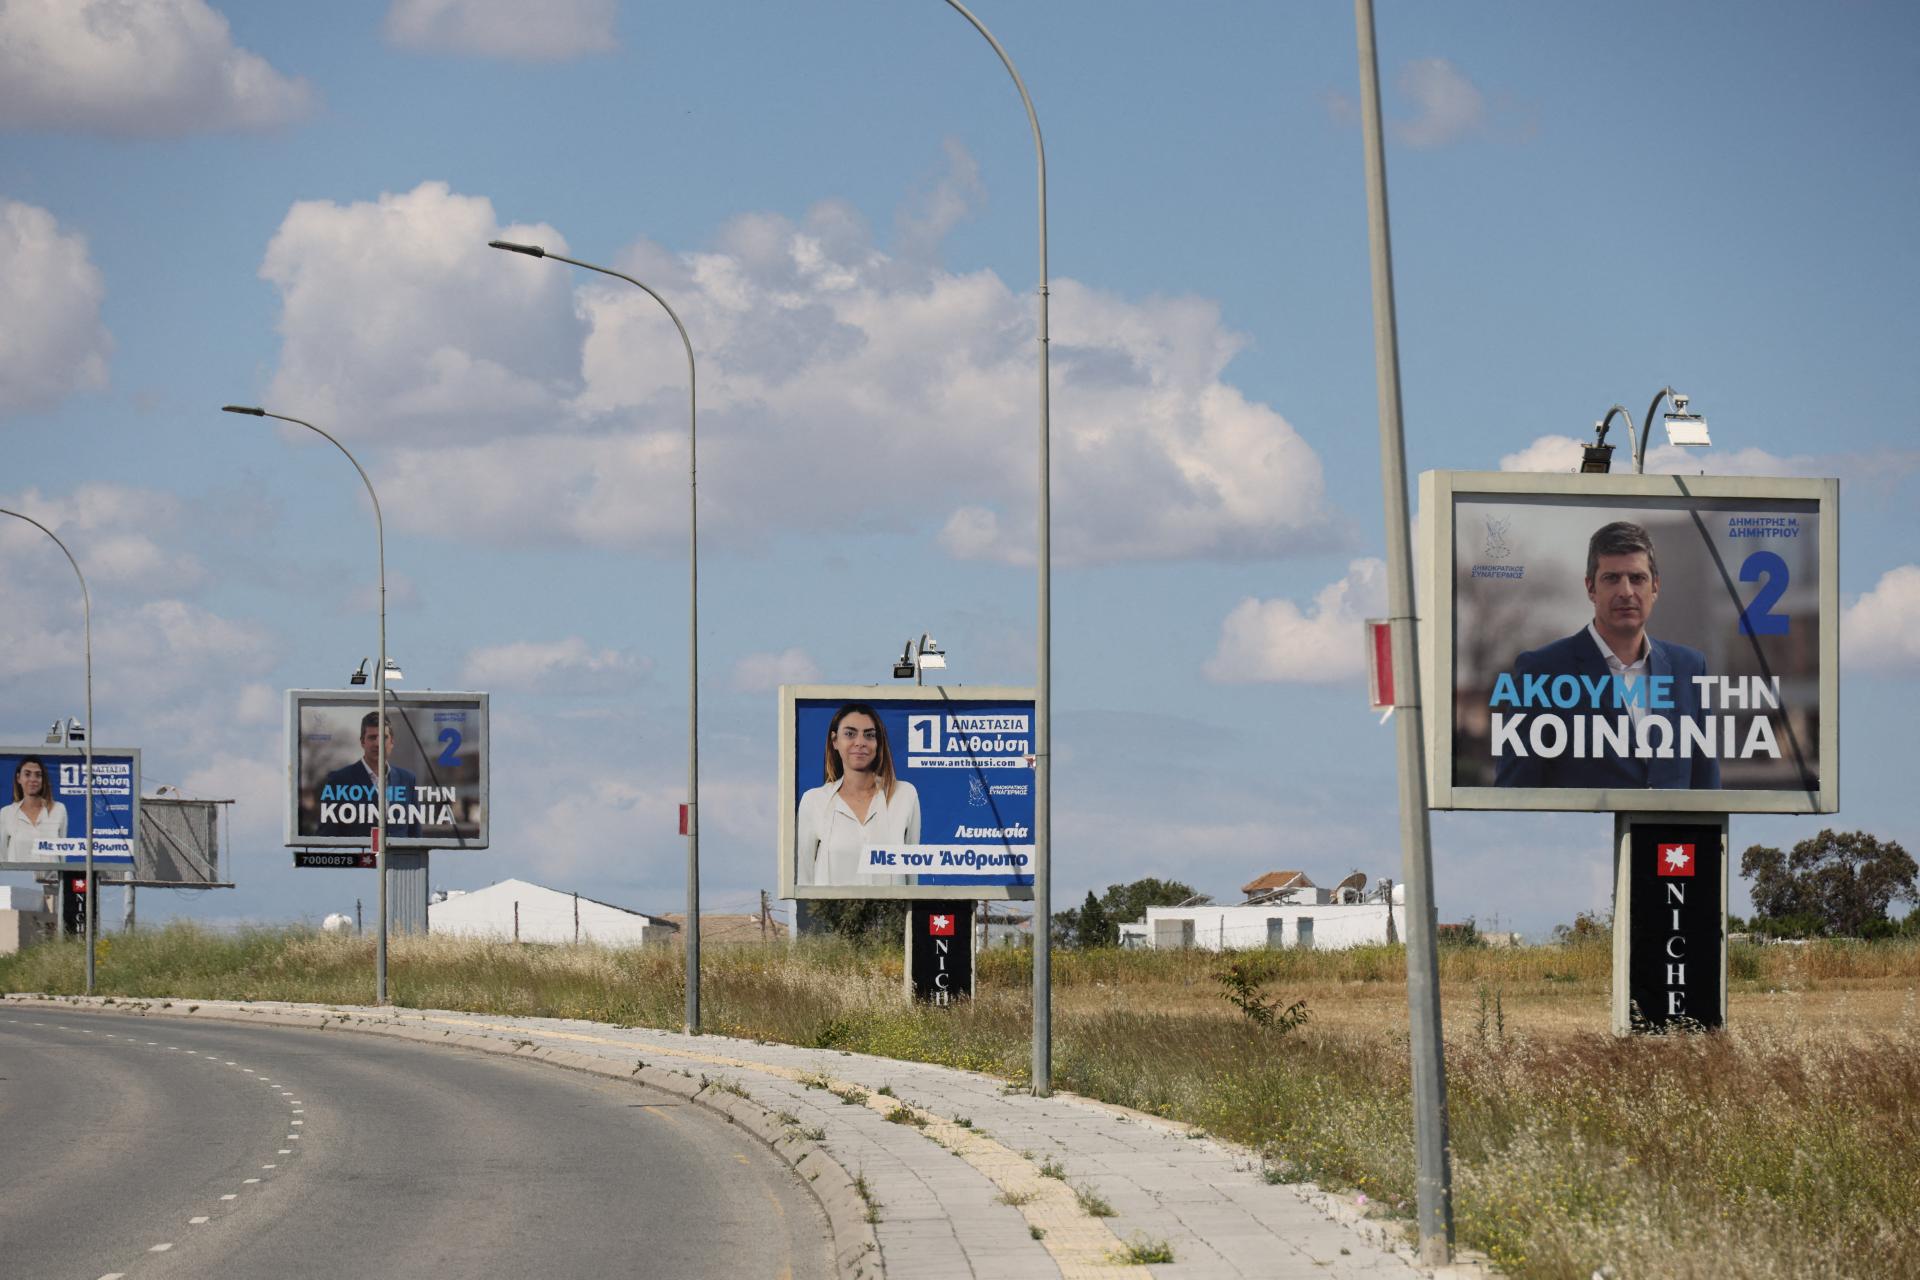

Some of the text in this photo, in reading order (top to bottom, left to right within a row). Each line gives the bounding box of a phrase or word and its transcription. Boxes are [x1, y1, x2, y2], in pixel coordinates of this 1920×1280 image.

[1728, 517, 1785, 527] ΔΗΜΗΤΡΗΣ
[1728, 528, 1800, 538] ΔΗΜΗΤΡΙΟΥ
[1738, 551, 1791, 636] 2
[1488, 672, 1781, 710] ΑΚΟΥΜΕ ΤΗΝ
[914, 720, 932, 749] 1
[951, 719, 1024, 730] ΑΝΑΣΤΑΣΙΑ
[946, 734, 1029, 755] Ανθούση
[1491, 712, 1782, 759] ΚΟΙΝΩΝΙΑ
[438, 727, 464, 767] 2
[920, 758, 1016, 767] www.anthousi.com
[64, 766, 74, 785] 1
[414, 786, 456, 803] ΤΗΝ
[320, 803, 456, 825] ΚΟΙΝΩΝΙΑ
[955, 823, 1029, 838] Λευκωσία
[38, 841, 53, 851] Με
[79, 841, 129, 853] Άθρωπο
[302, 856, 354, 865] 70000878
[870, 848, 1028, 870] Με τον Άνθρωπο
[1666, 883, 1686, 1015] NICHE
